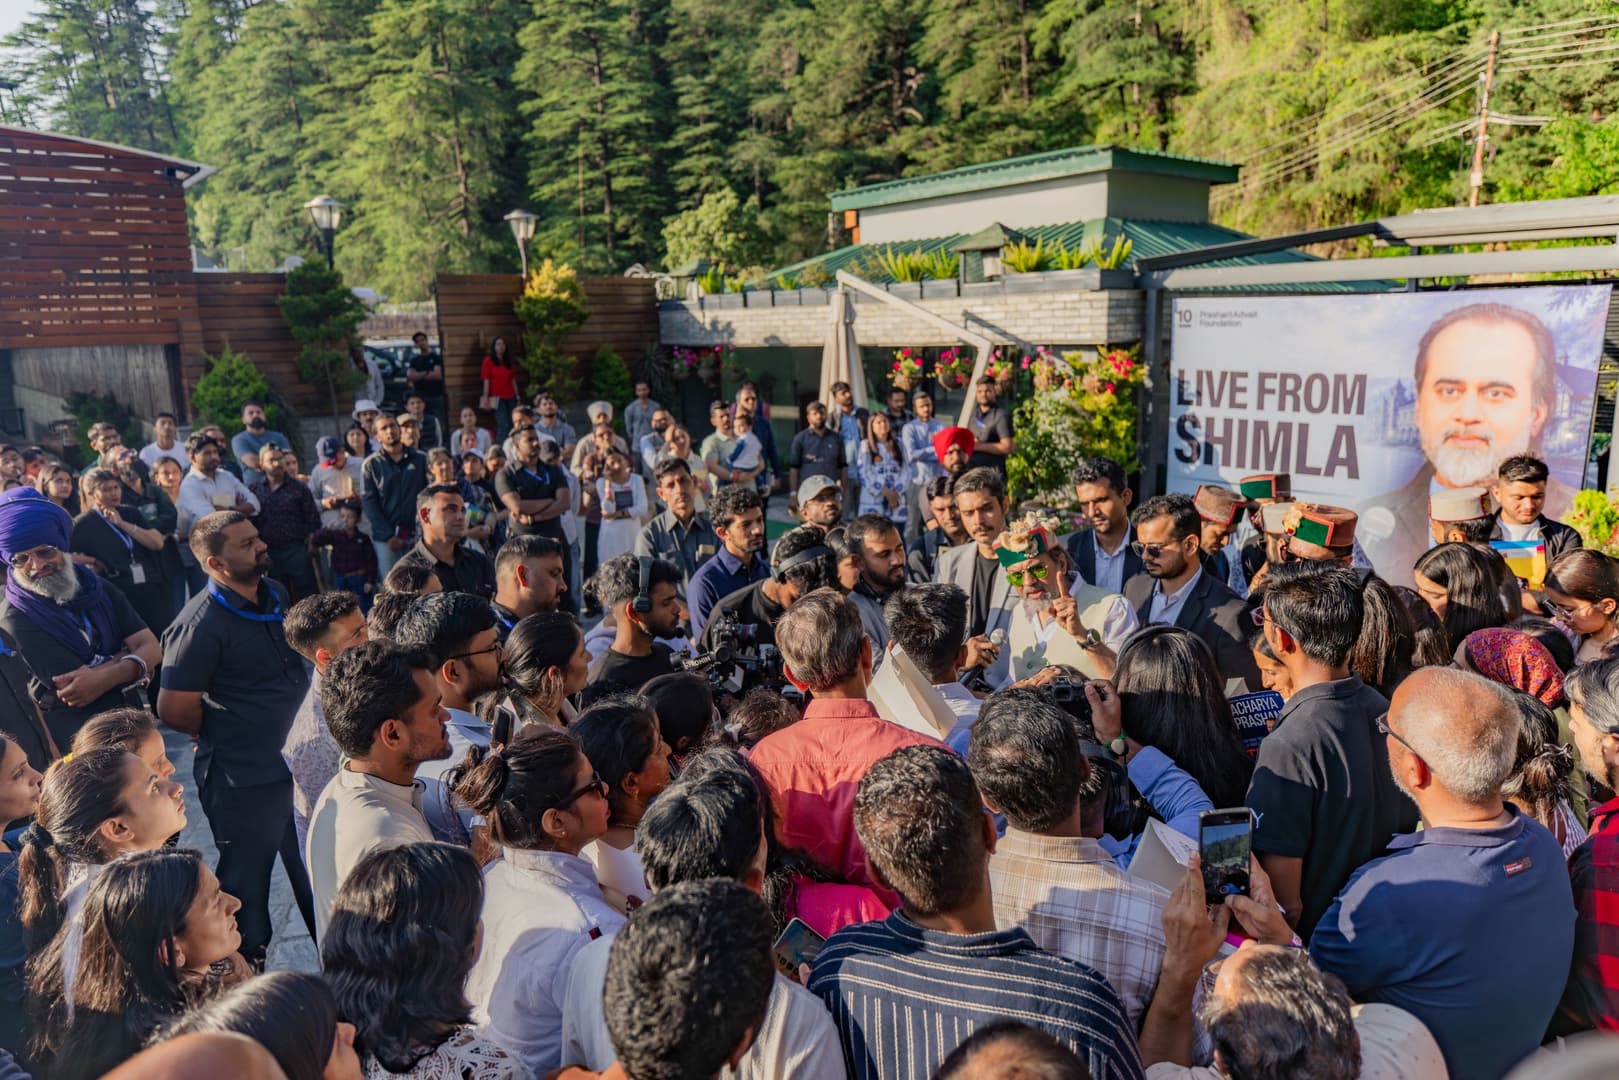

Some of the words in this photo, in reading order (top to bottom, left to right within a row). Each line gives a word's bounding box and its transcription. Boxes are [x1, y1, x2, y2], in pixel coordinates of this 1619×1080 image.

[1178, 309, 1192, 323] 10
[1177, 368, 1248, 409] LIVE
[1256, 372, 1367, 415] FROM
[1175, 413, 1360, 480] SHIMLA
[1231, 697, 1279, 717] ACHARYA
[1234, 710, 1280, 730] PRASHA
